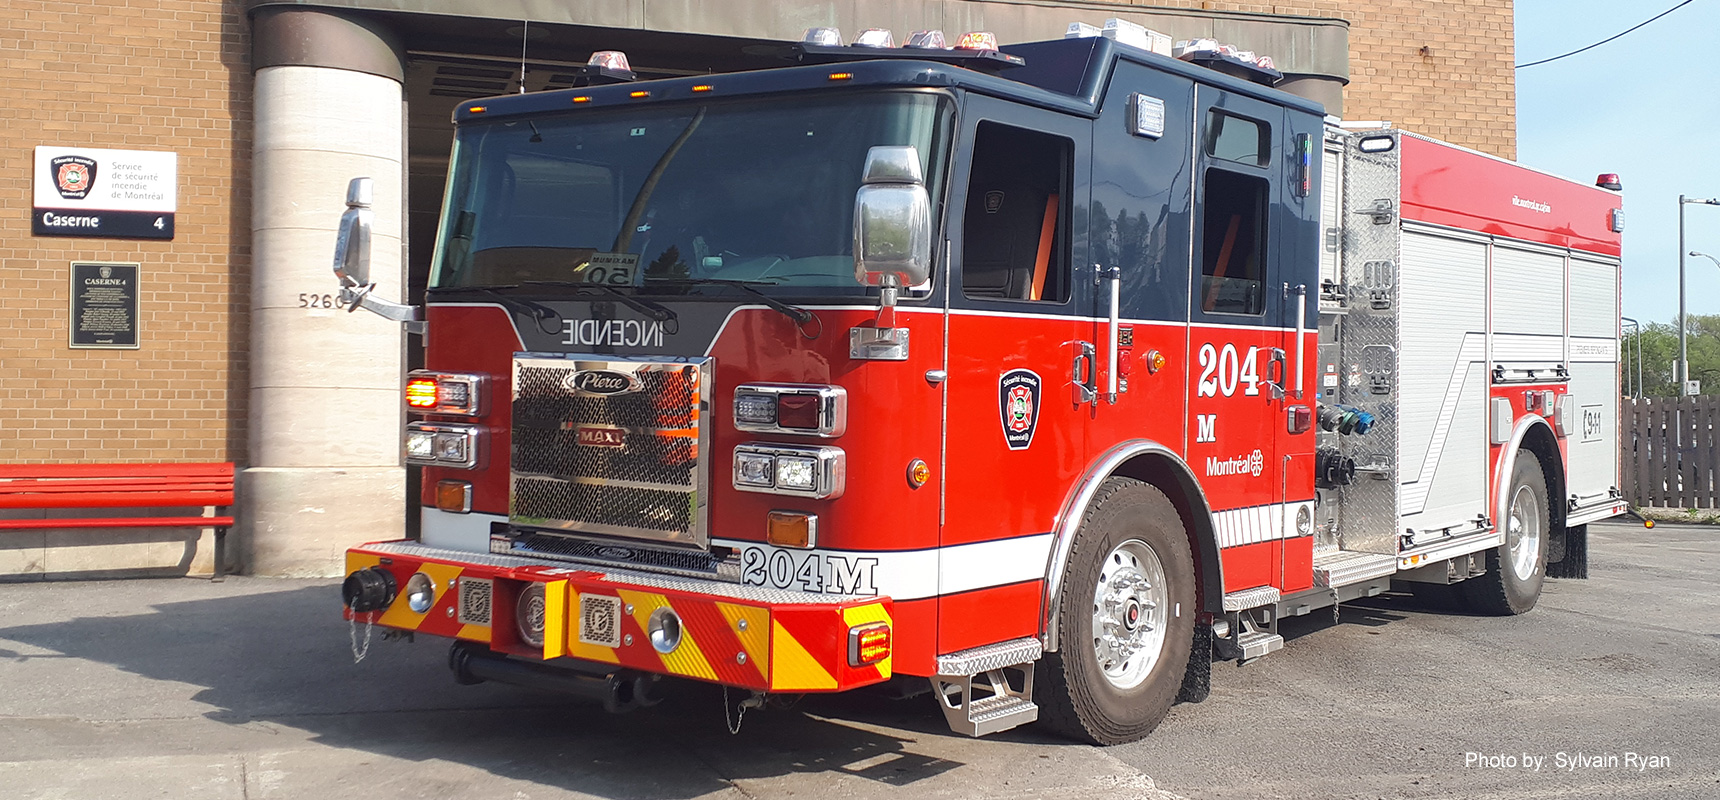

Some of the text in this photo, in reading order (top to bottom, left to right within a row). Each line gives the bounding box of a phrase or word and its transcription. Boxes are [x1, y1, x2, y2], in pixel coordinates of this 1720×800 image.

[111, 161, 142, 171] Service
[125, 172, 158, 181] sécurité
[111, 191, 164, 200] de Montréal
[43, 211, 164, 230] Caserne 4
[84, 278, 120, 286] CASERNE
[1197, 342, 1260, 398] 204
[581, 372, 624, 390] Pierce
[1196, 414, 1217, 443] M
[1206, 454, 1251, 477] Montréal
[743, 546, 879, 596] 204M
